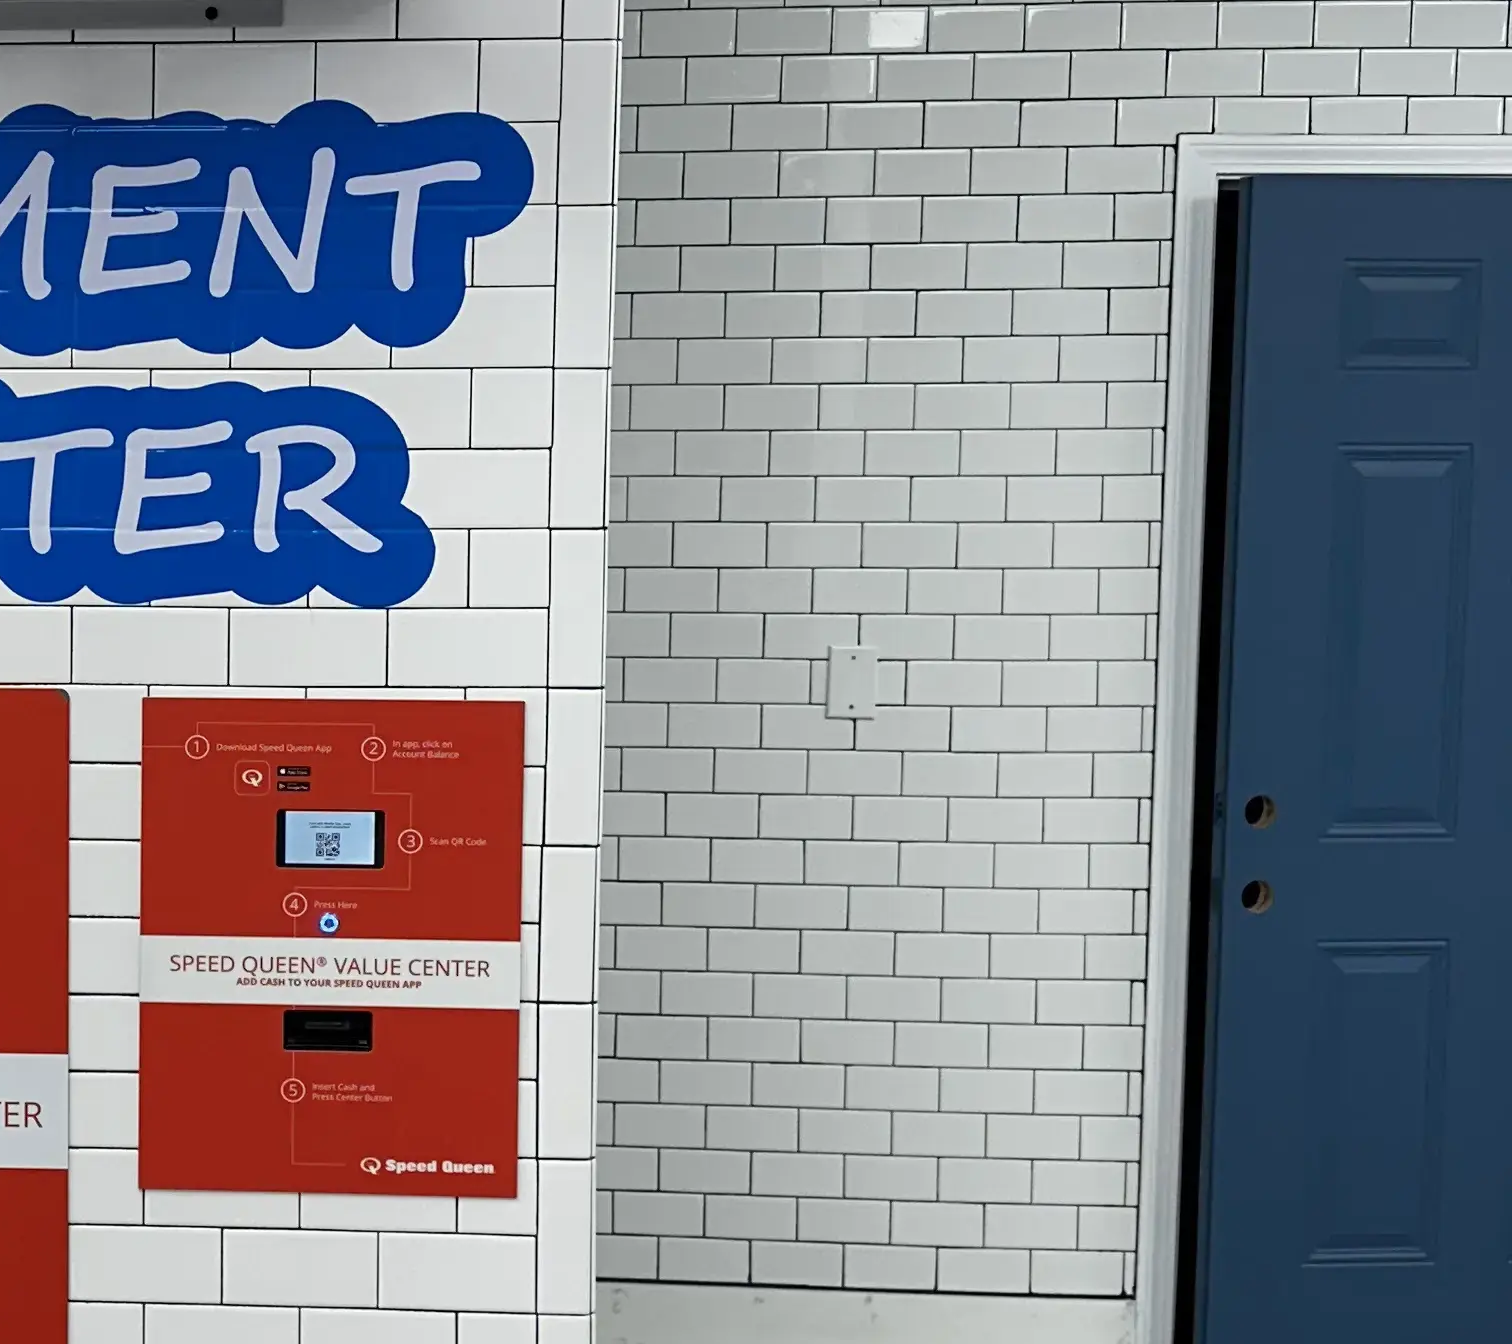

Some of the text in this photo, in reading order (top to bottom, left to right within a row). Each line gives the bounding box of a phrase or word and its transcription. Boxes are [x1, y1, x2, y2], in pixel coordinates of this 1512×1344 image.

[216, 743, 332, 754] Download Speed Queen App
[392, 740, 401, 748] In
[422, 740, 440, 748] click
[441, 741, 453, 749] on
[392, 750, 460, 759] Account Balance
[429, 837, 487, 847] Scan QR Code
[313, 900, 358, 910] Press Here
[169, 955, 235, 972] SPEED
[334, 957, 401, 976] VALUE
[408, 958, 490, 978] CENTER
[236, 977, 423, 989] ADD CASH TO YOUR SPEED QUEEN APP
[311, 1082, 376, 1092] Insert Cash and
[311, 1092, 393, 1102] Press Center Button
[385, 1159, 438, 1175] Speed
[441, 1160, 495, 1174] Queen
